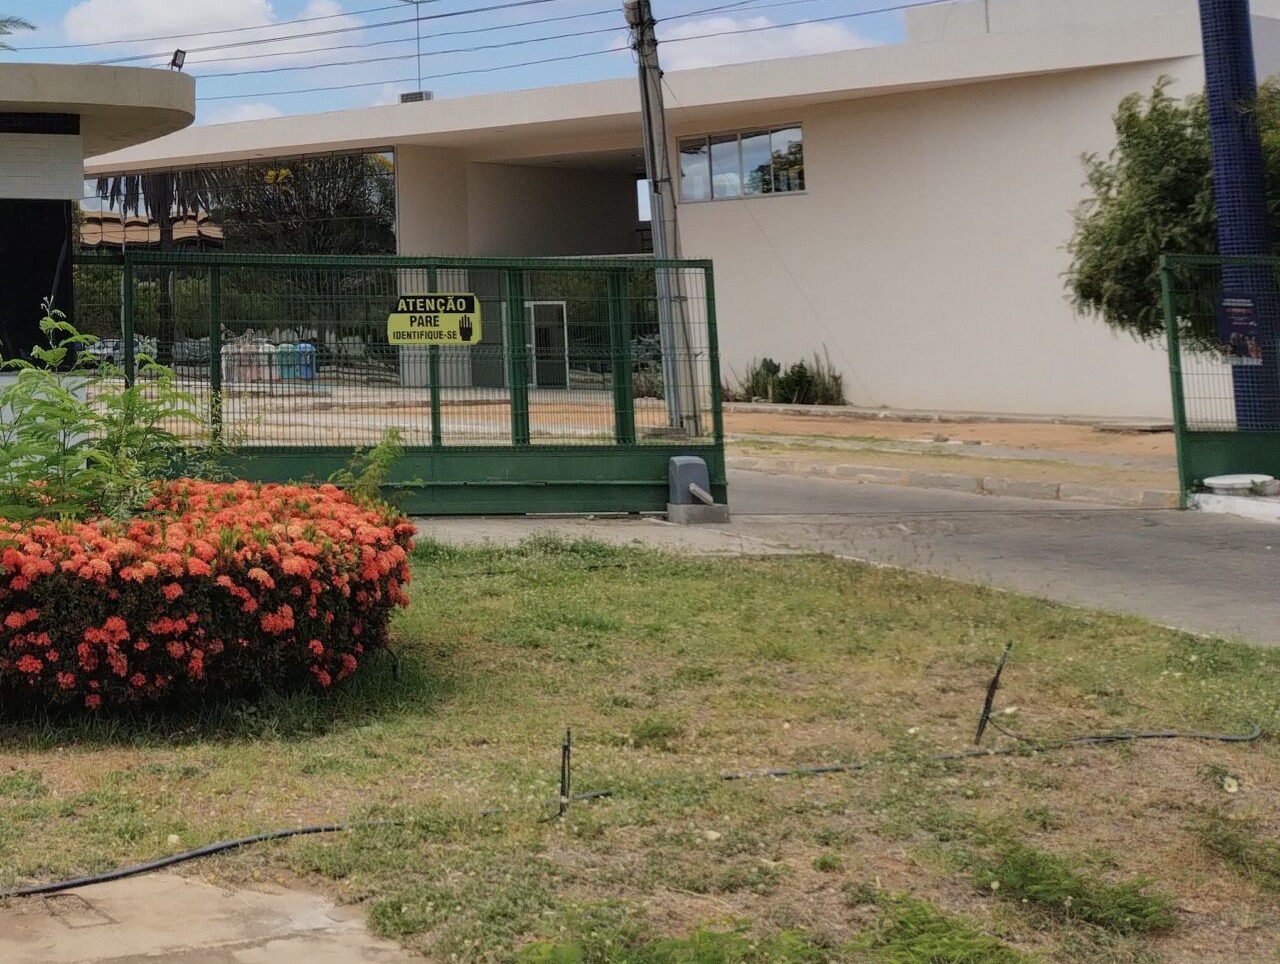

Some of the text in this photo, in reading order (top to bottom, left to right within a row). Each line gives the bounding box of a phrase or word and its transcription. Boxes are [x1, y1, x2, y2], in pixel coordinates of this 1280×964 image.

[397, 296, 466, 314] ATENÇÃO
[410, 315, 440, 327] PARE
[393, 330, 457, 340] IDENTIFIQUE-SE
